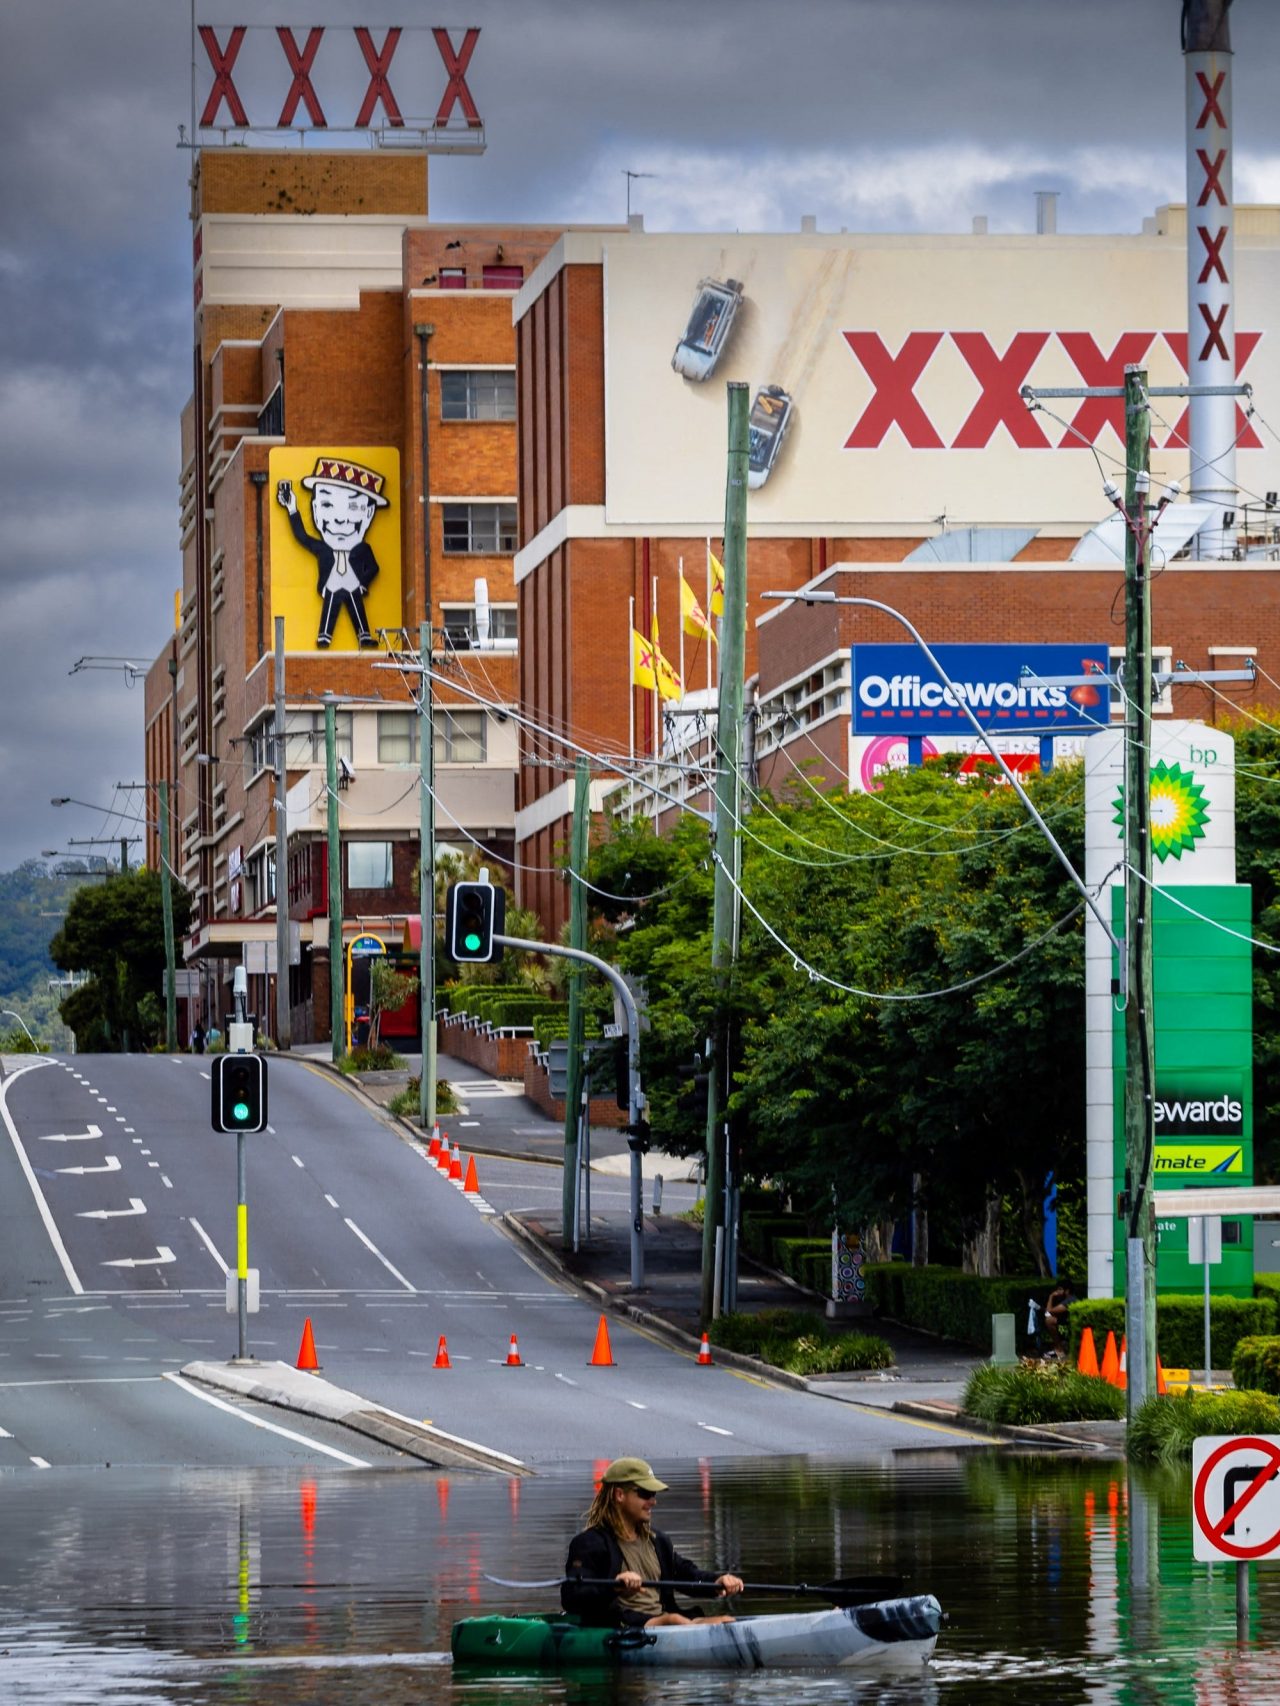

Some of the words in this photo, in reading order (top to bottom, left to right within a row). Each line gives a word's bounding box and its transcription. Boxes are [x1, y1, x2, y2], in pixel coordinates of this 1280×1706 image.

[197, 25, 483, 128] XXXX
[317, 460, 380, 490] XXXX
[859, 675, 1068, 708] Officeworks
[1190, 745, 1218, 768] bp
[1154, 1094, 1242, 1122] ewards
[1153, 1154, 1207, 1170] imate
